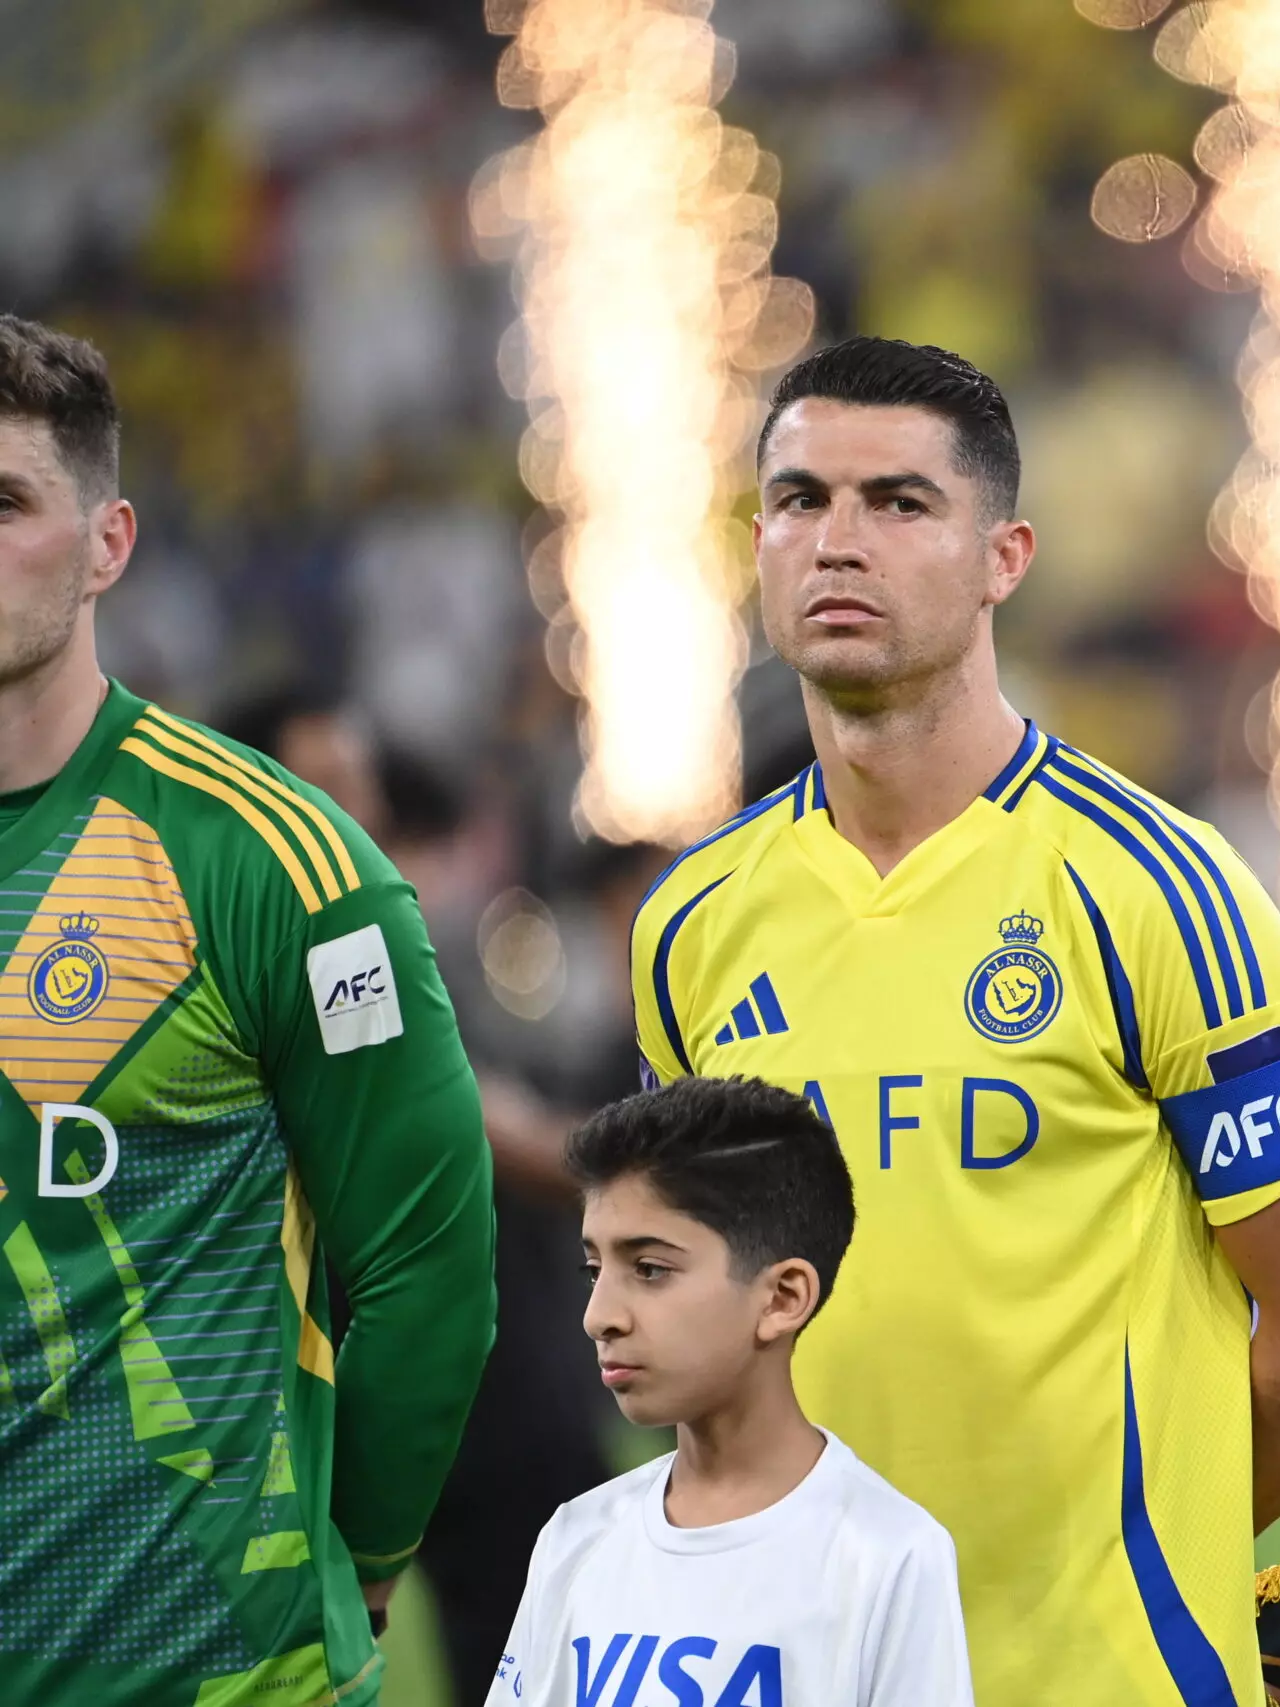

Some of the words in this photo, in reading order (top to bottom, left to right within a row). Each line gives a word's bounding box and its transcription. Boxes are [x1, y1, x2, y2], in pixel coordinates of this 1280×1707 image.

[47, 949, 62, 966] AL
[64, 945, 100, 969] NASSR
[985, 961, 1004, 978] AL
[1006, 954, 1048, 980] NASSR
[323, 965, 386, 1011] AFC
[37, 993, 71, 1016] FOOTBALL
[978, 1008, 1020, 1034] FOOTBALL
[1022, 1009, 1044, 1030] CLUB
[571, 1633, 783, 1707] VISA
